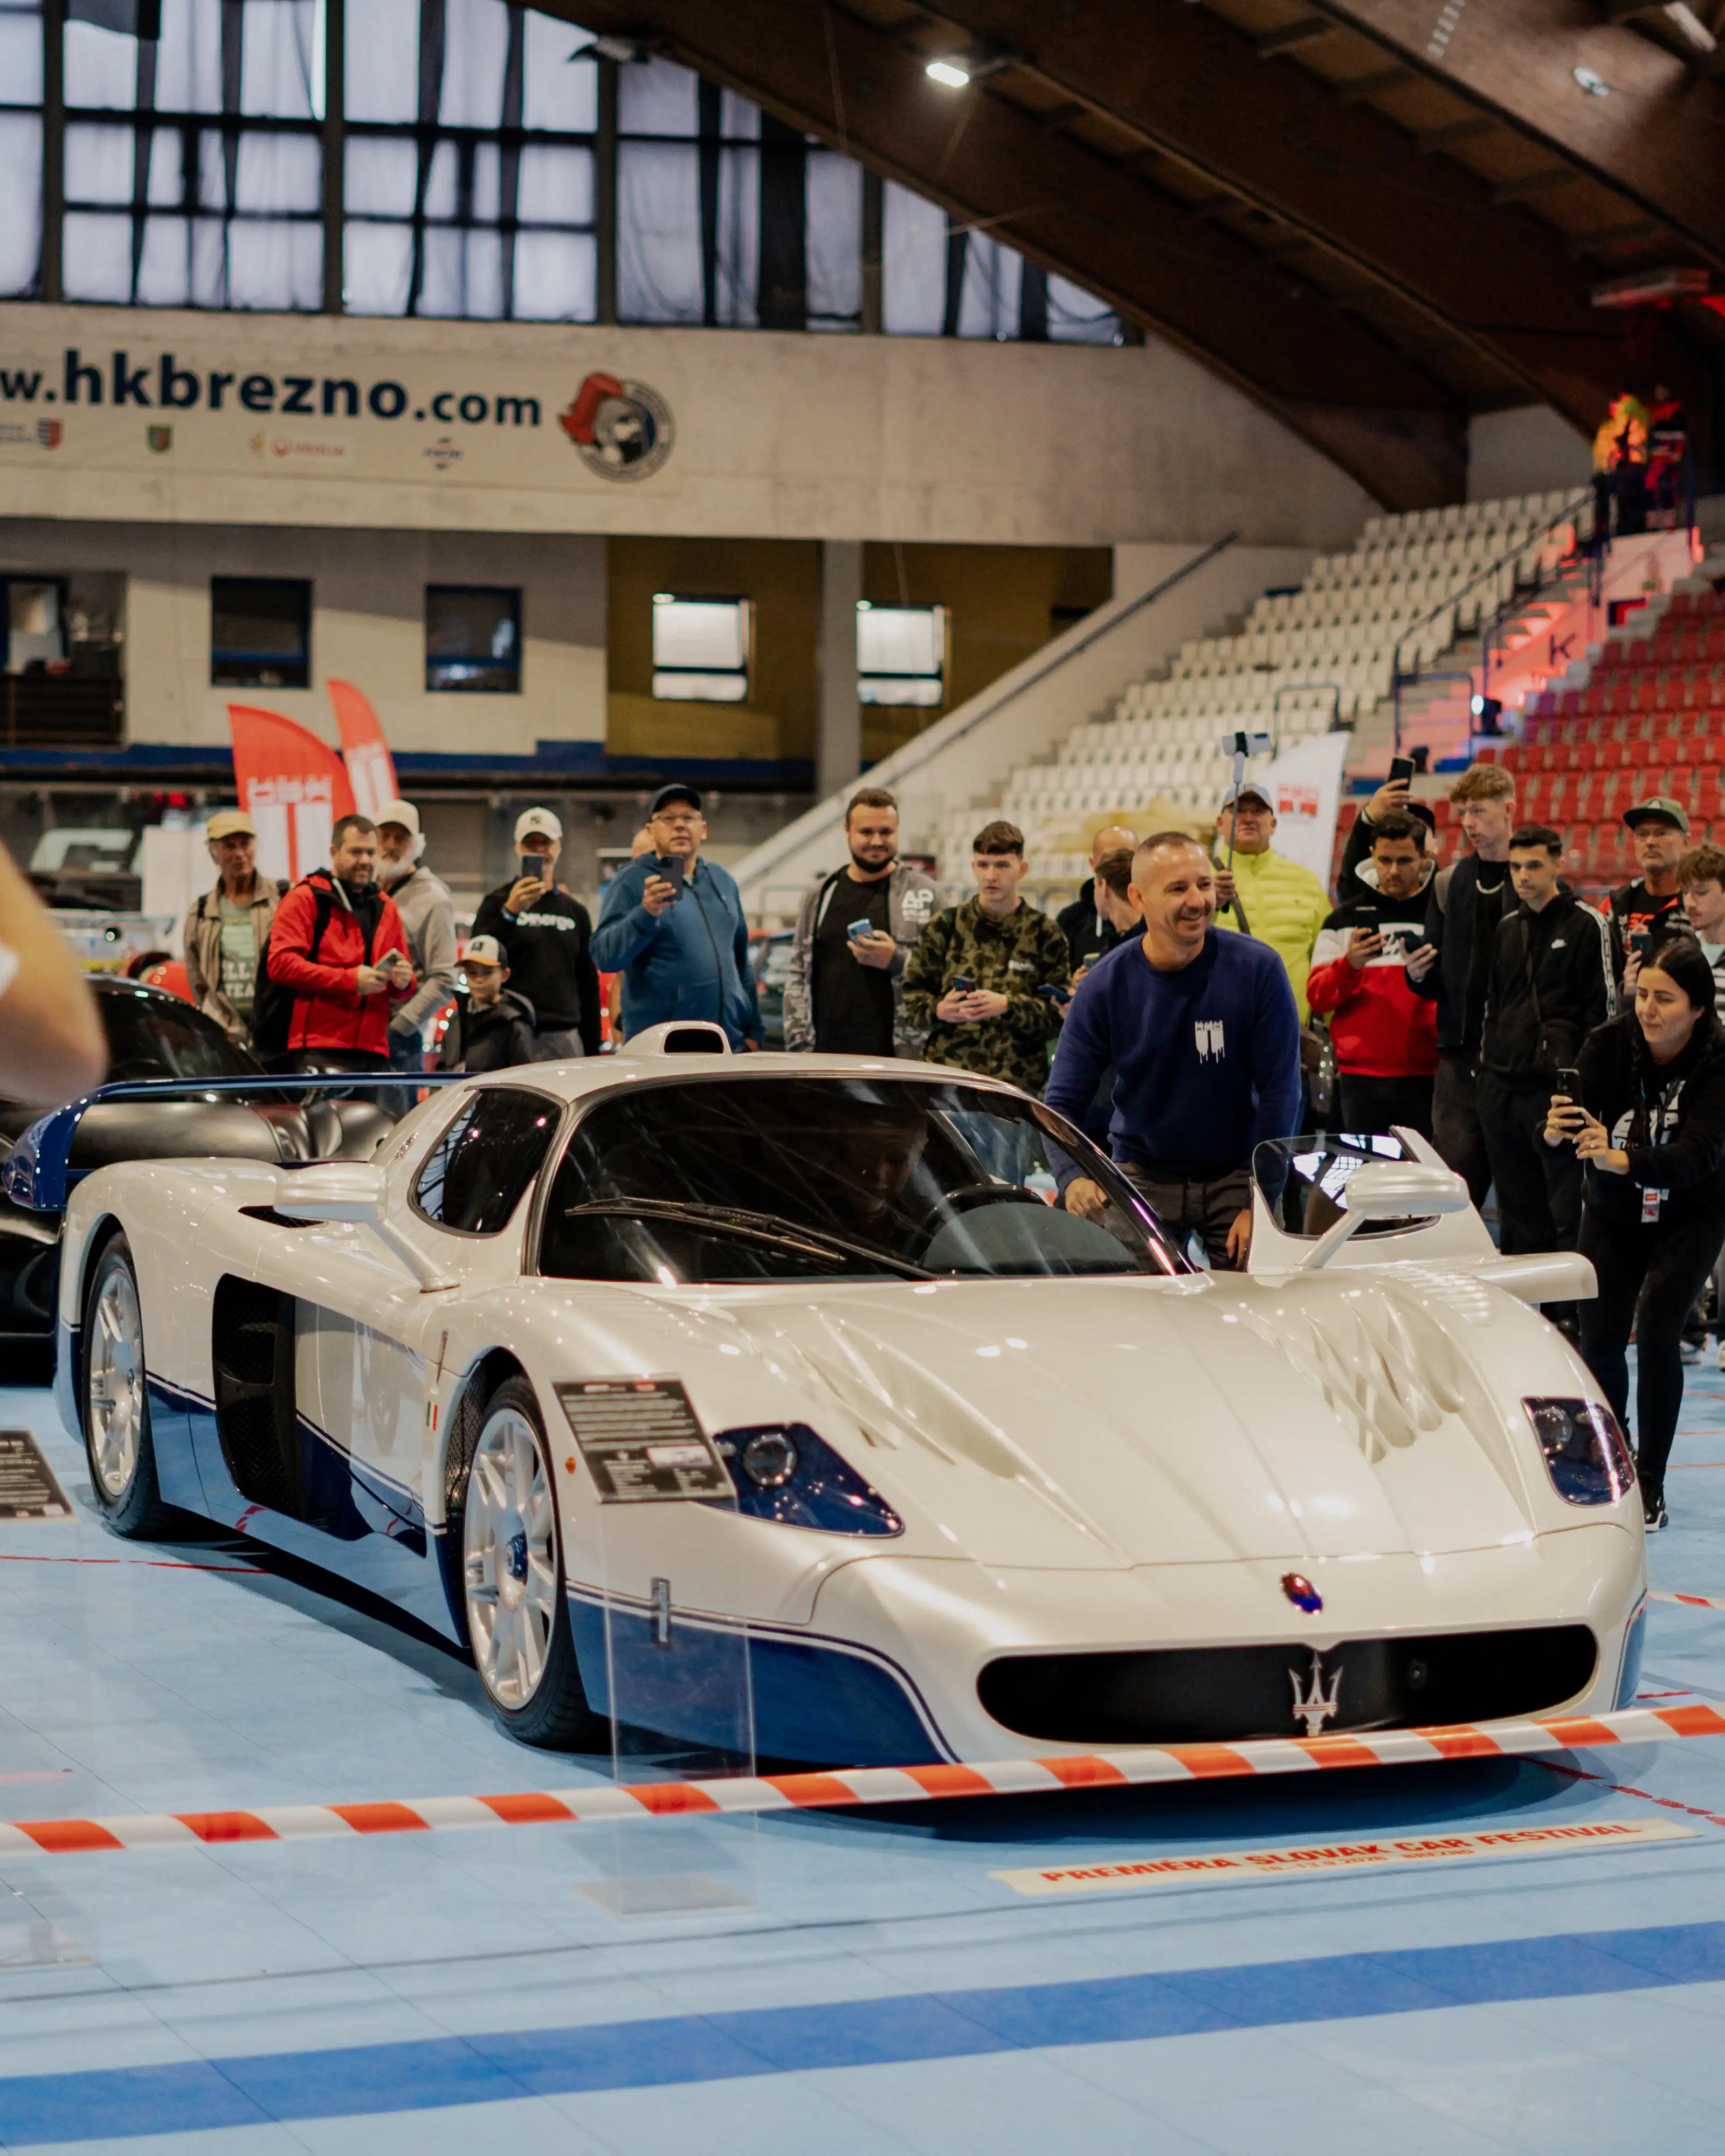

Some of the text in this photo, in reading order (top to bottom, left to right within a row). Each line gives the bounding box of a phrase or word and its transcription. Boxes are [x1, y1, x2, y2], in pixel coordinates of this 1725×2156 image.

[1549, 633, 1576, 666] K
[1038, 1825, 1643, 1881] PREMIÉRA SLOVAK CAR FESTIVAL
